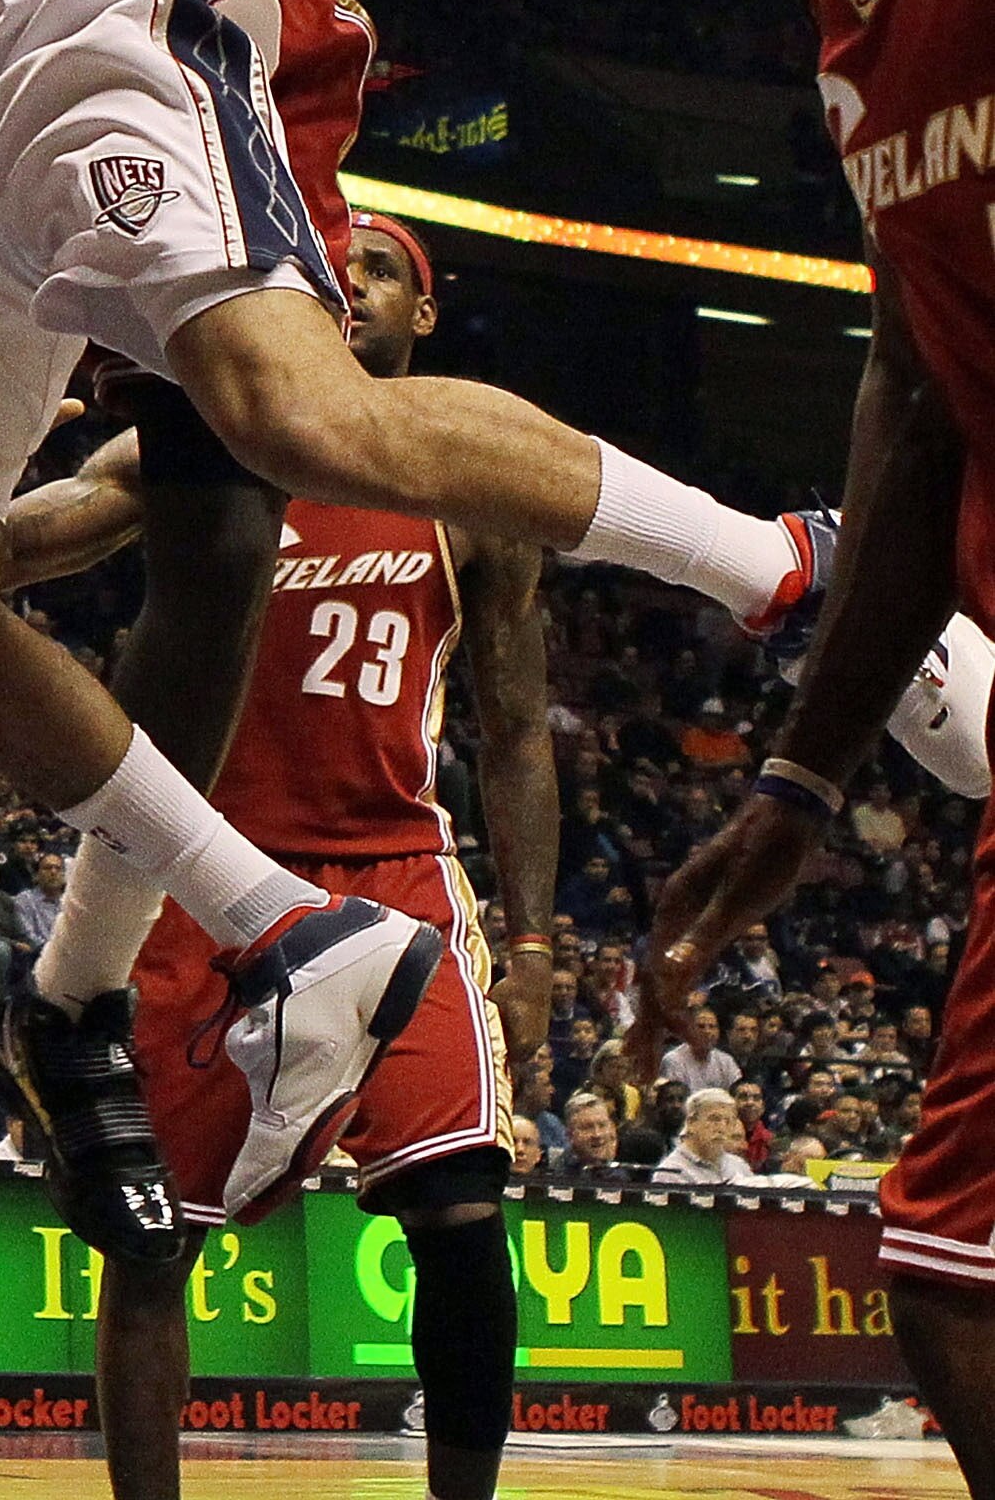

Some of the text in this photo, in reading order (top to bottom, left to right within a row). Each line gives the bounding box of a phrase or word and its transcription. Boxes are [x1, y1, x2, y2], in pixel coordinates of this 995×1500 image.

[99, 159, 163, 202] NETS
[302, 600, 411, 707] 23
[190, 1233, 277, 1324] t's
[355, 1215, 668, 1335] GYA
[731, 1256, 790, 1335] it
[255, 1390, 362, 1430] Locker
[512, 1393, 610, 1432] Locker
[681, 1394, 839, 1433] Foot Locker
